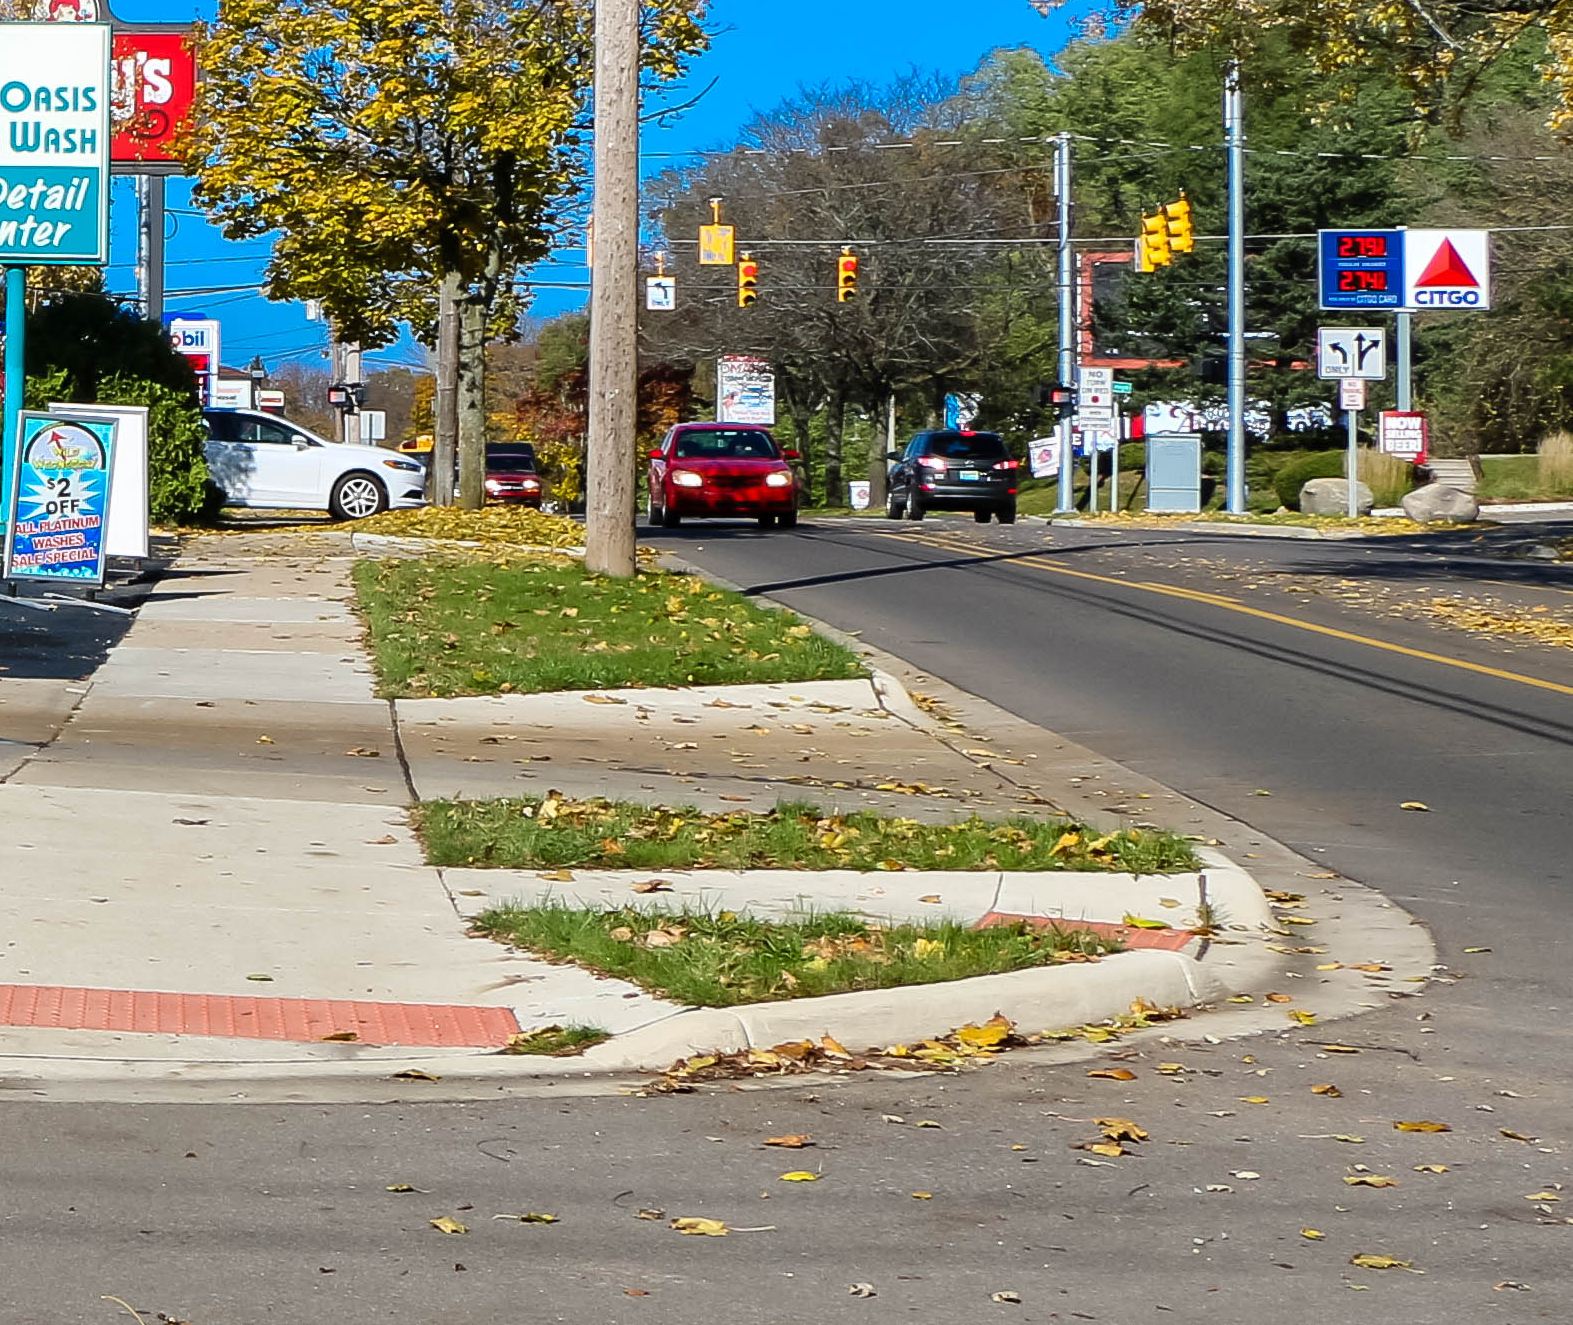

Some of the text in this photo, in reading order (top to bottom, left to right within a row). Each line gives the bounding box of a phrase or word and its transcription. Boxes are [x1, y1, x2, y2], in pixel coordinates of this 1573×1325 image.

[9, 121, 97, 154] WASH
[1414, 290, 1480, 305] CITGO
[171, 330, 205, 347] obil
[46, 477, 72, 498] $2
[45, 498, 81, 516] OFF
[15, 515, 100, 535] ALL PLATINUM
[32, 534, 85, 550] WASHES
[12, 548, 98, 567] SALE SPECIAL
